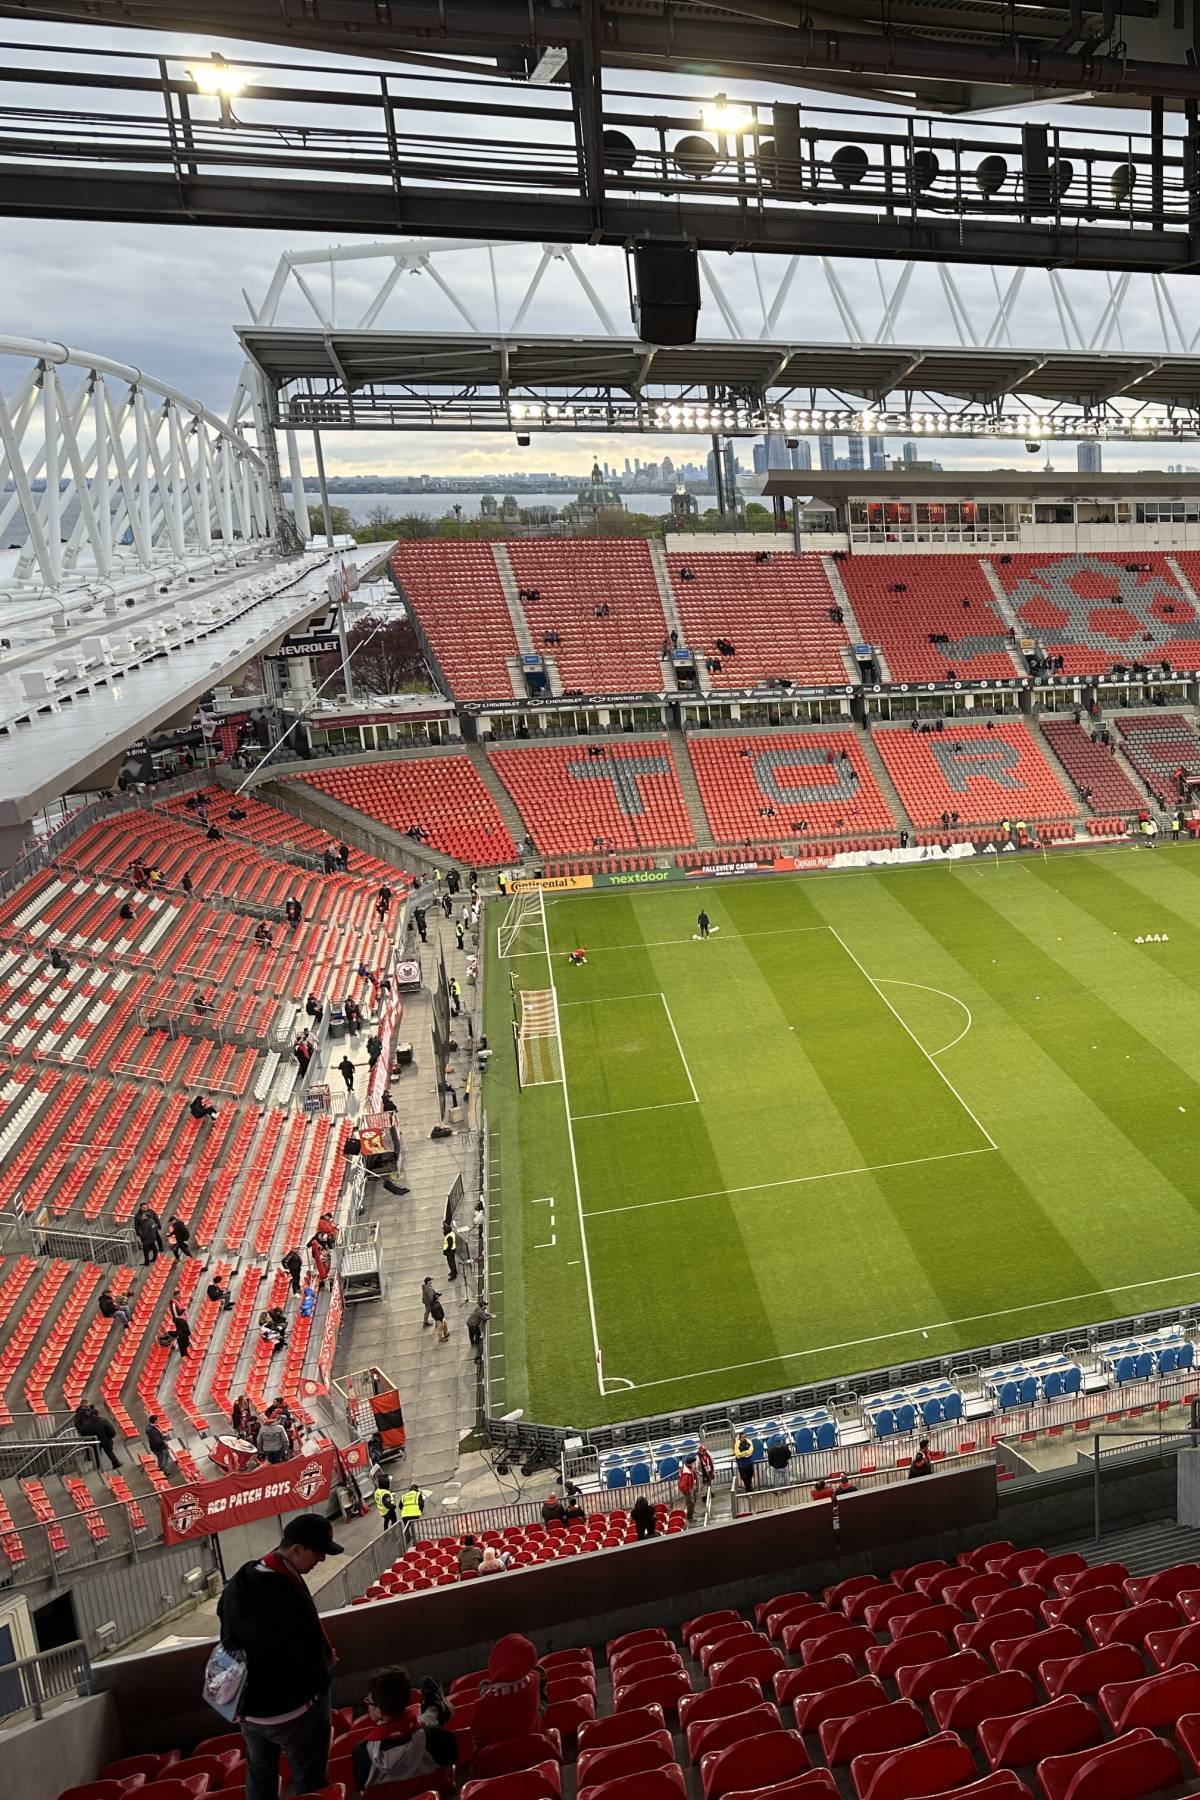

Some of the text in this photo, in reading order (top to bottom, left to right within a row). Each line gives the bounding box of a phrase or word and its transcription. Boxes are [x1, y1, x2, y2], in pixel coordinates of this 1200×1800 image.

[193, 718, 226, 730] CHLET
[702, 862, 757, 873] FALLSVIEW CASINO
[610, 872, 669, 884] nextdoor
[207, 1481, 291, 1515] RED PATCH BOYS
